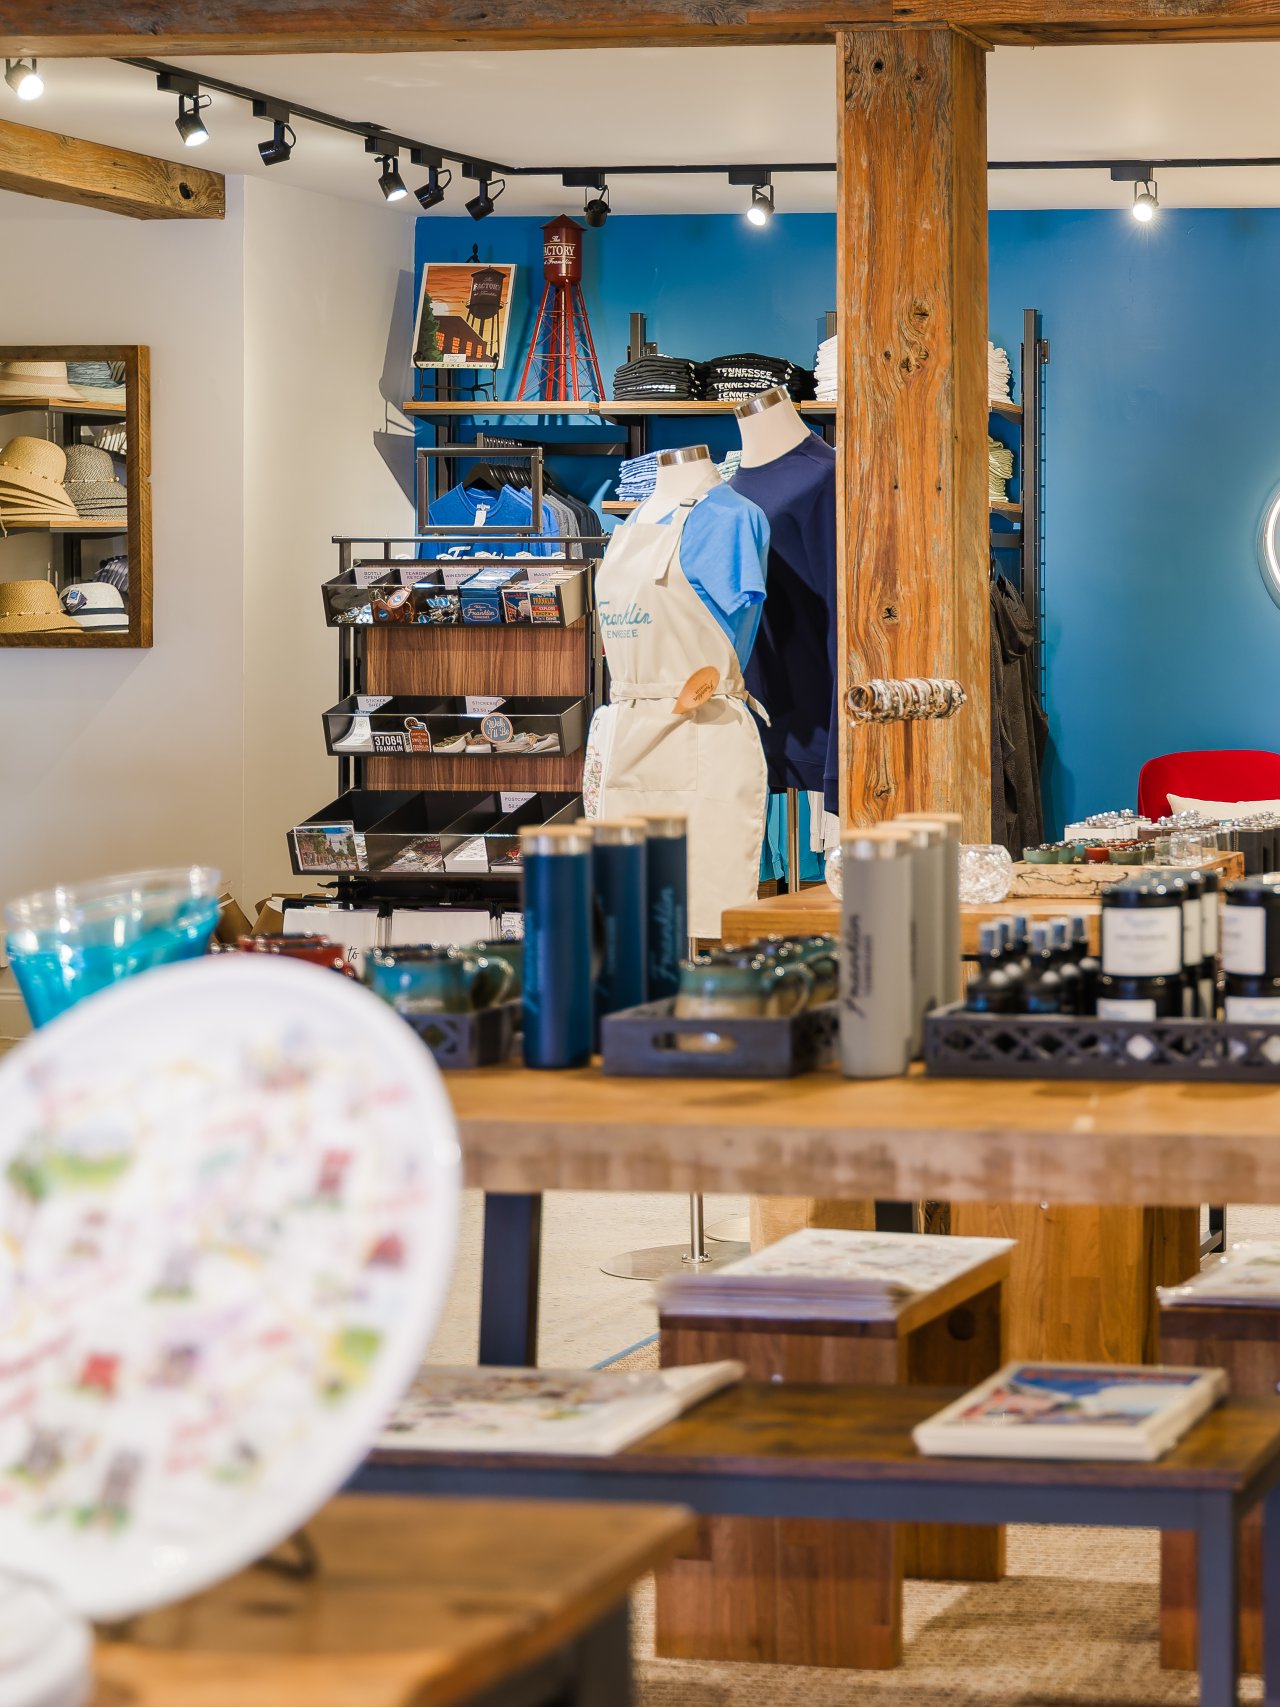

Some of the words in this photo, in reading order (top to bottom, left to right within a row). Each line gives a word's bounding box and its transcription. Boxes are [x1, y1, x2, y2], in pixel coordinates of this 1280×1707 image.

[713, 381, 768, 390] TENNESSEE
[467, 608, 495, 617] Franklin
[374, 734, 403, 745] 37064
